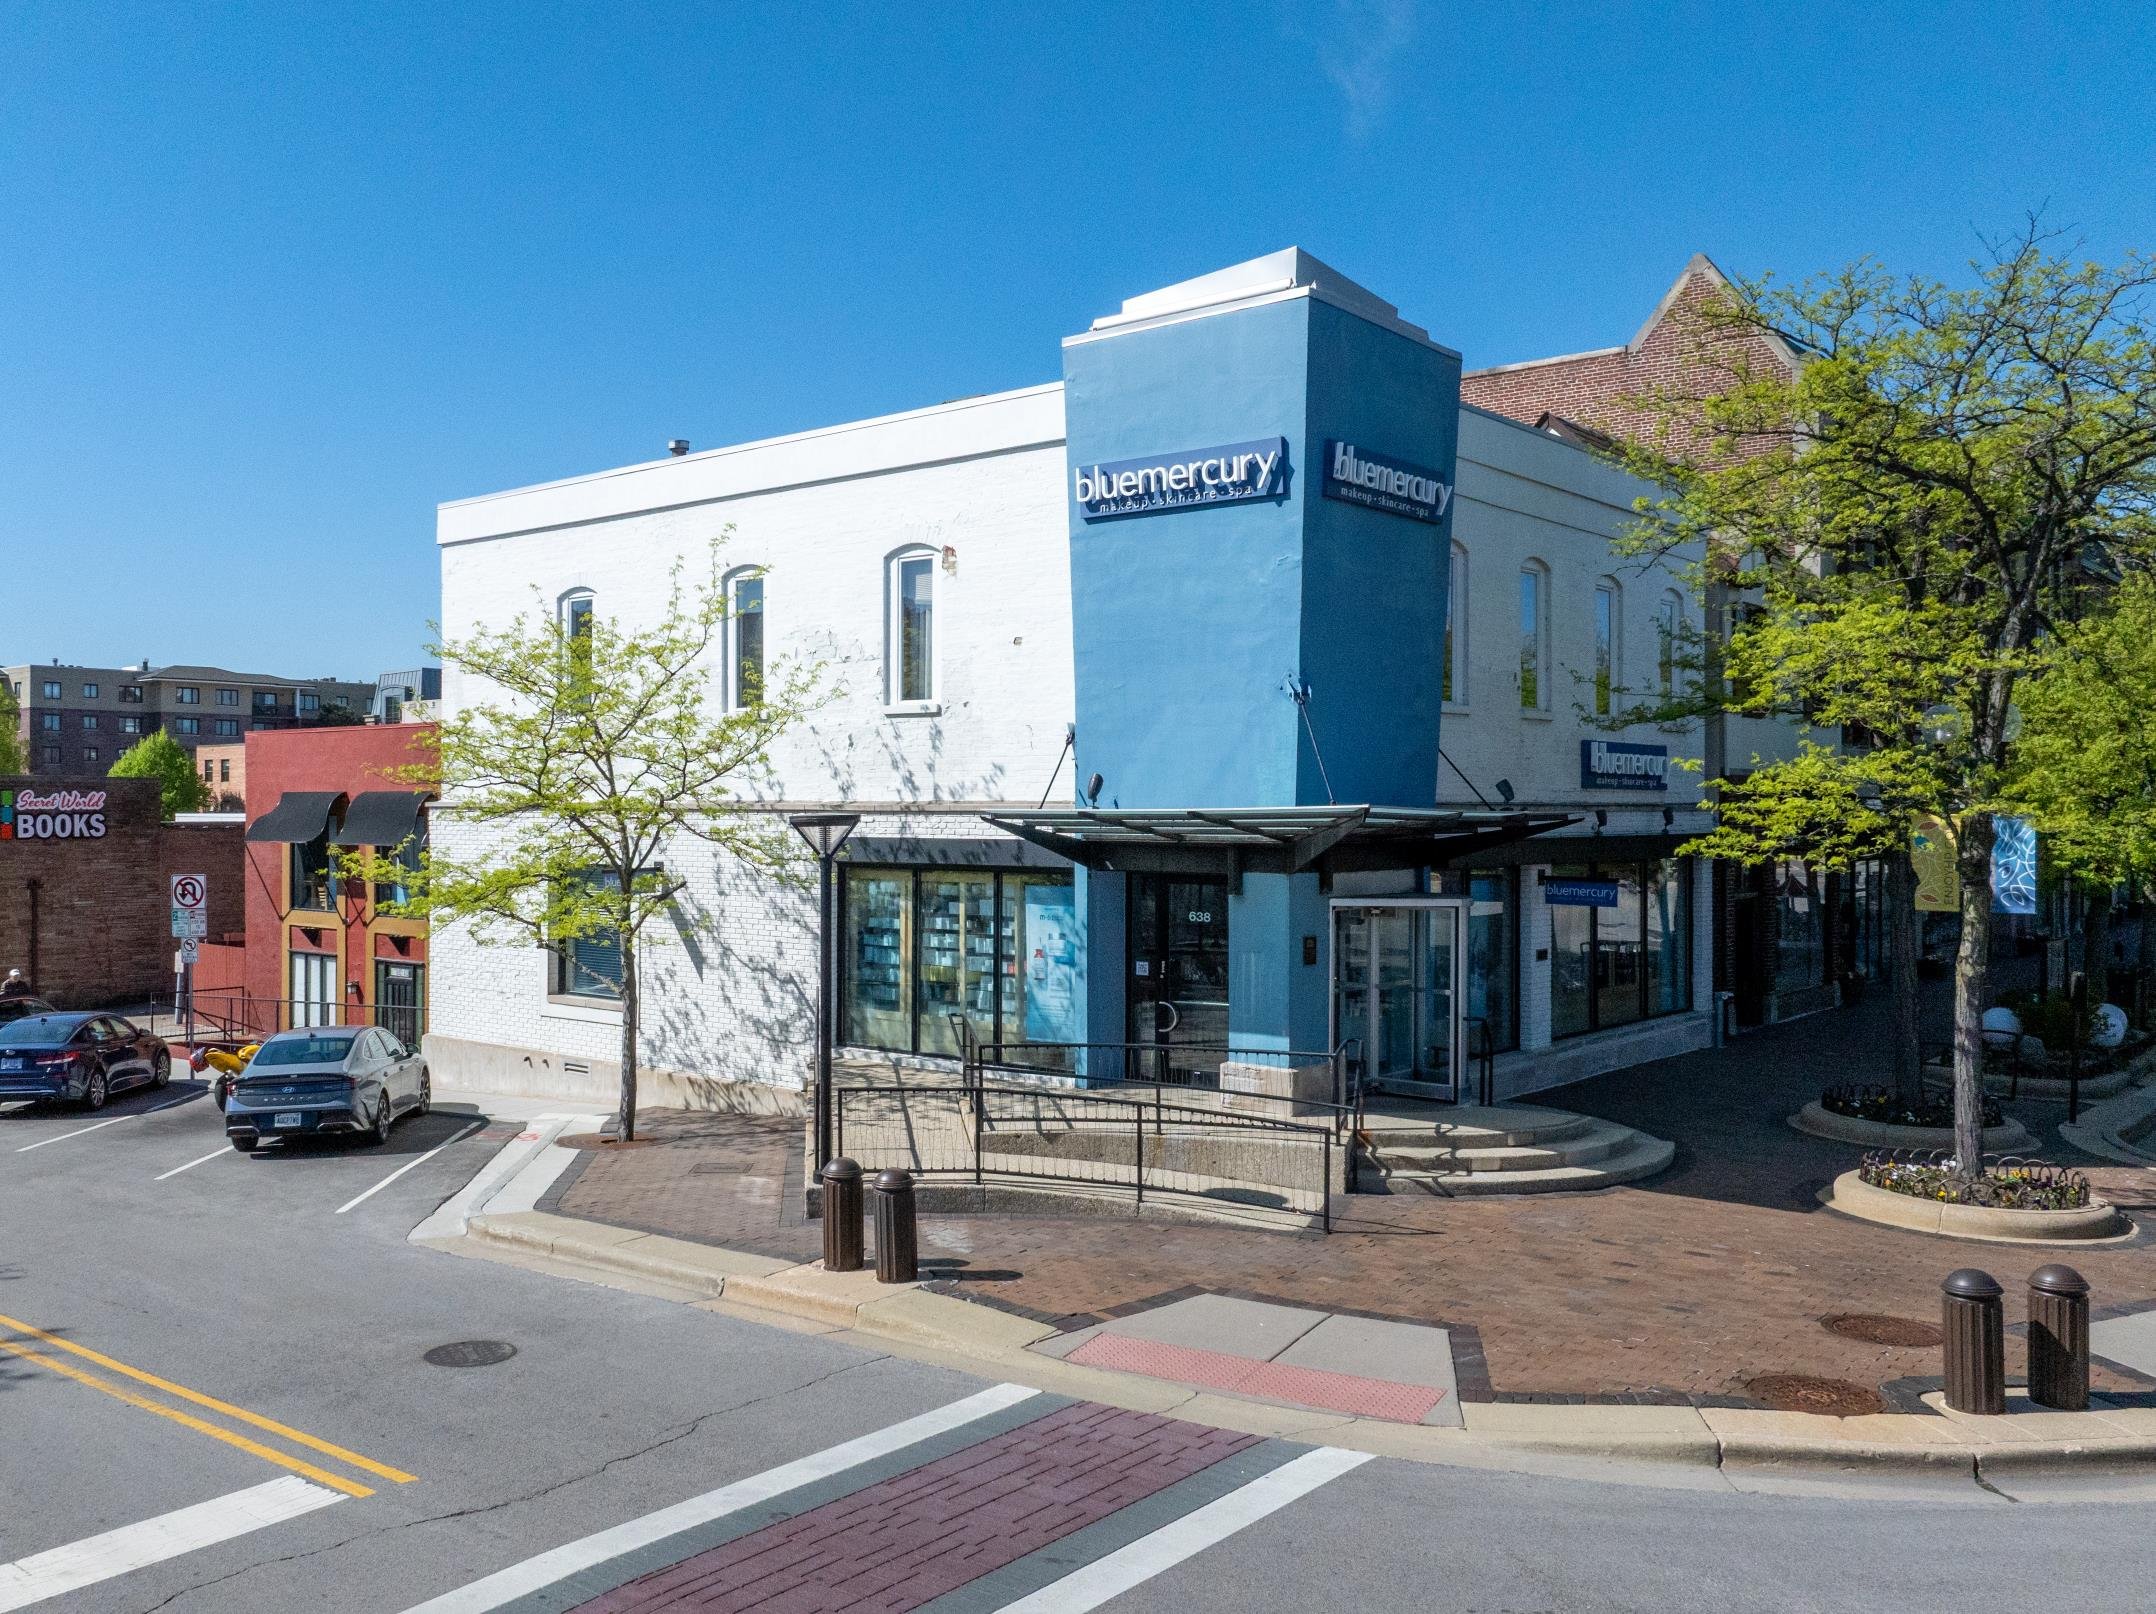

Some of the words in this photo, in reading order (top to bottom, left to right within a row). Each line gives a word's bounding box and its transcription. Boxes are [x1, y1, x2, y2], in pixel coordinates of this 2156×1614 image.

[1075, 450, 1277, 502] bluemercury
[1333, 441, 1453, 516] bluemercury
[1100, 498, 1149, 514] makeup
[1159, 490, 1217, 506] skincare
[1228, 486, 1253, 497] spa
[1341, 487, 1372, 504] makeup
[1378, 494, 1412, 512] skincare
[1415, 506, 1429, 519] spa
[17, 790, 59, 810] Secret
[59, 790, 106, 811] World
[17, 814, 106, 838] BOOKS
[1547, 883, 1616, 900] bluemercury
[1188, 911, 1211, 923] 638
